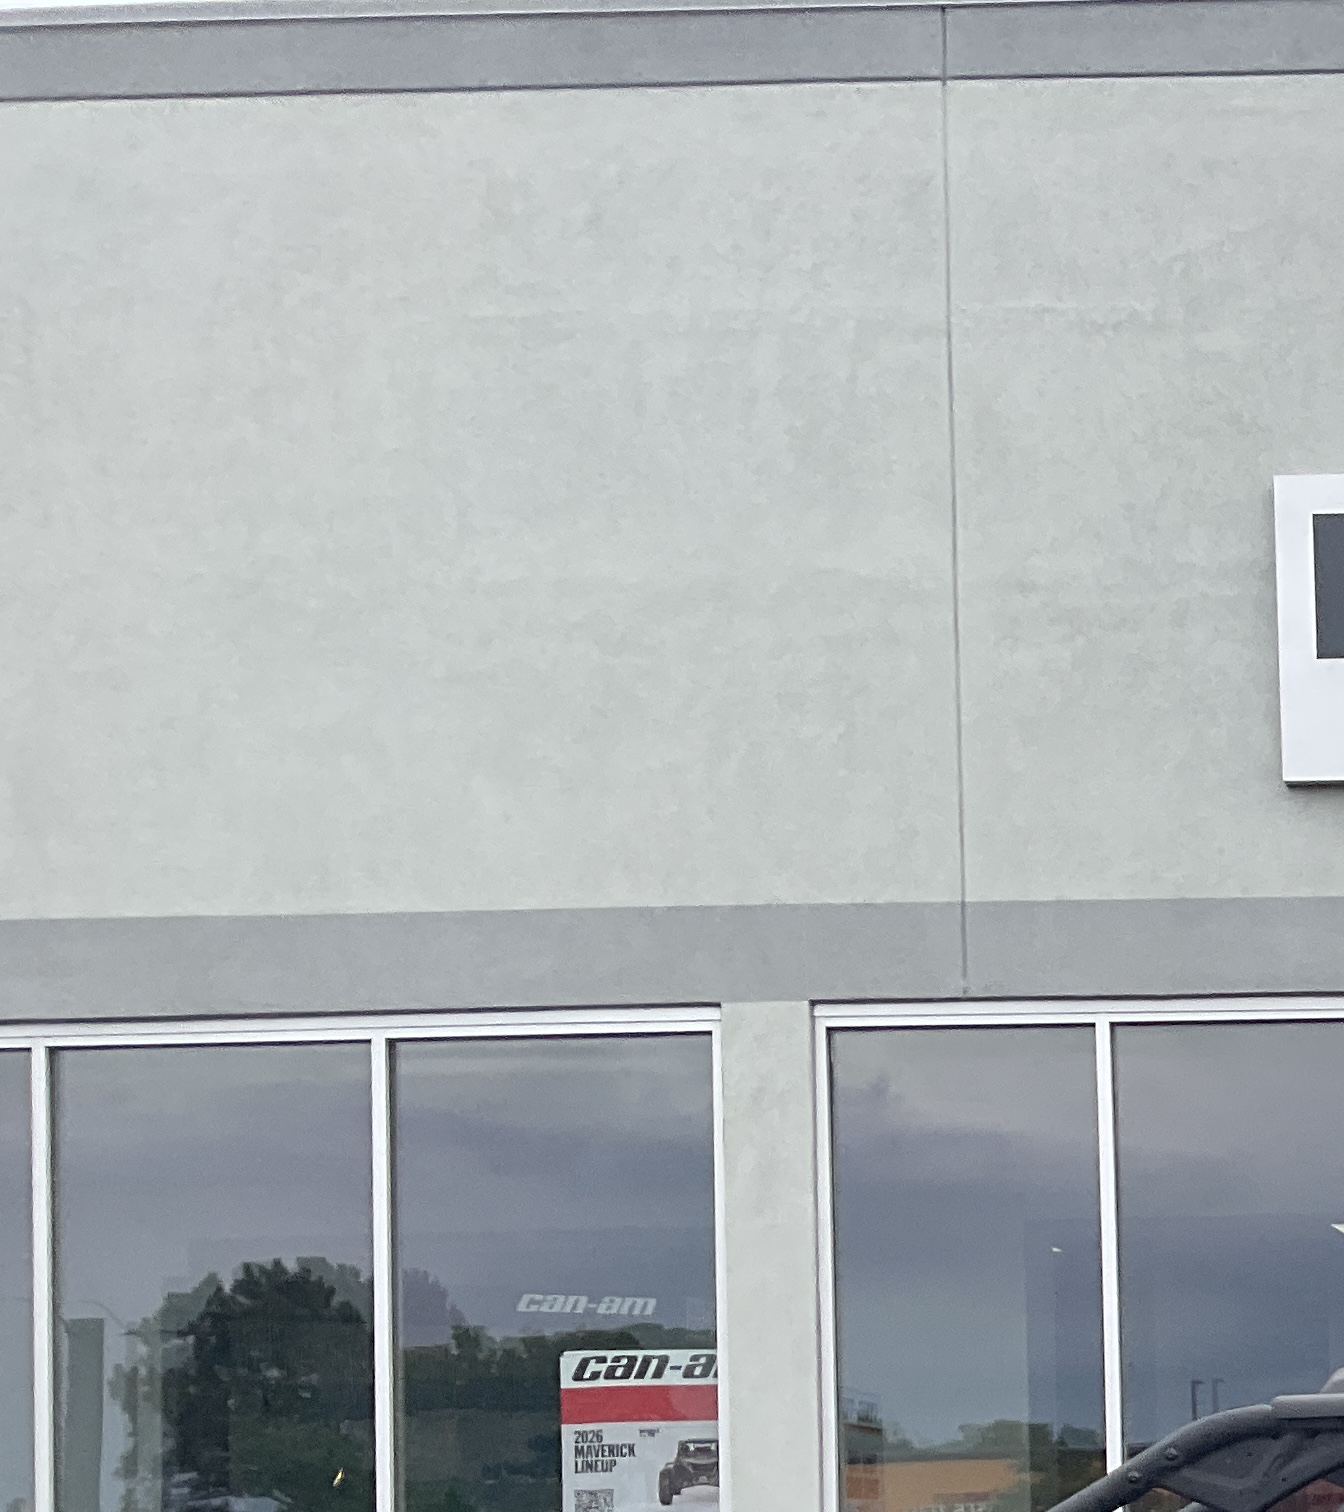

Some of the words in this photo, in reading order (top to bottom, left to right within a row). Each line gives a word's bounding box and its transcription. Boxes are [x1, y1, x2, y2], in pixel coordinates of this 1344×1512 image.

[516, 1293, 657, 1315] can-am
[571, 1353, 717, 1382] can-a
[573, 1429, 603, 1444] 2026
[574, 1443, 637, 1458] MAVERICK
[574, 1459, 617, 1474] LINEUP
